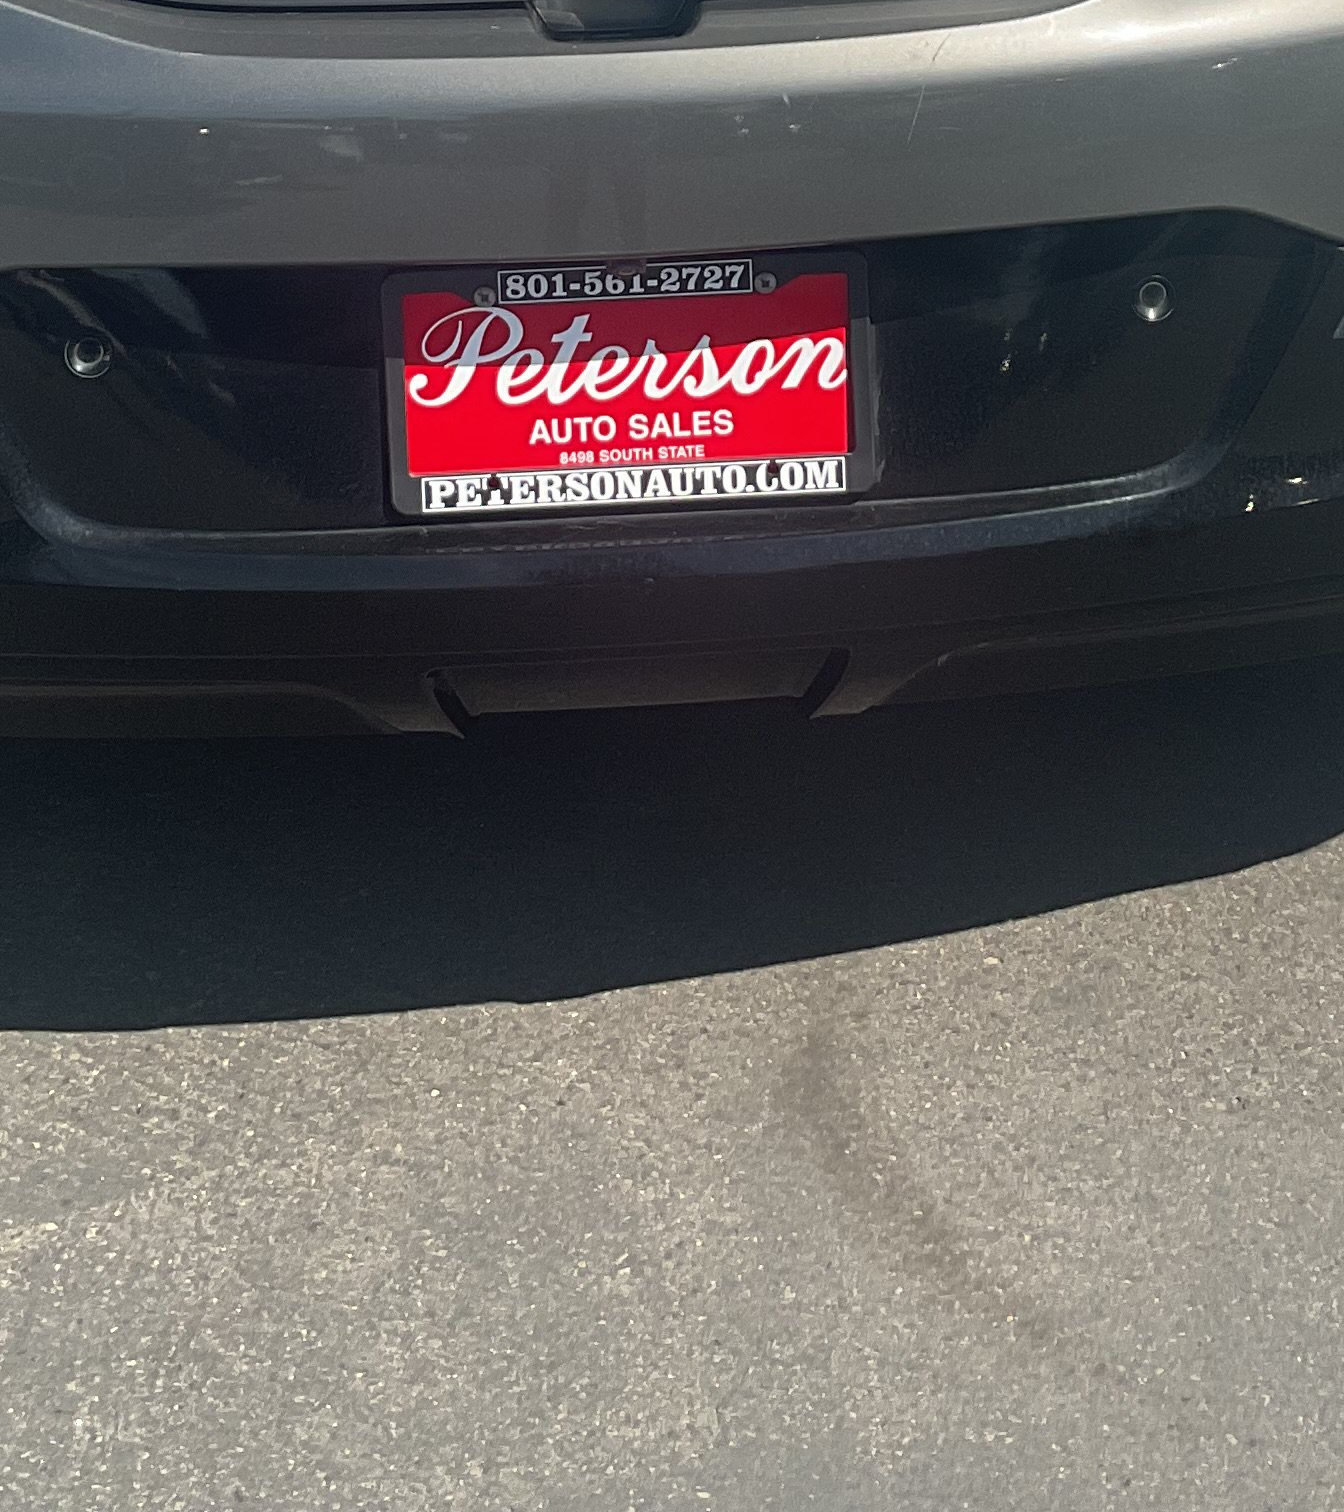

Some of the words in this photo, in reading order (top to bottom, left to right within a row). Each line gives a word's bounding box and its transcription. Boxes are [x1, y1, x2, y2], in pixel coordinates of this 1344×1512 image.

[506, 265, 745, 299] 801-561-2727
[409, 306, 847, 407] Peterson
[529, 415, 616, 445] AUTO
[629, 409, 734, 440] SALES
[560, 450, 594, 464] 8498
[600, 448, 653, 462] SOUTH
[658, 445, 705, 459] STATE
[429, 460, 839, 508] PETERSONAUTO.COM
